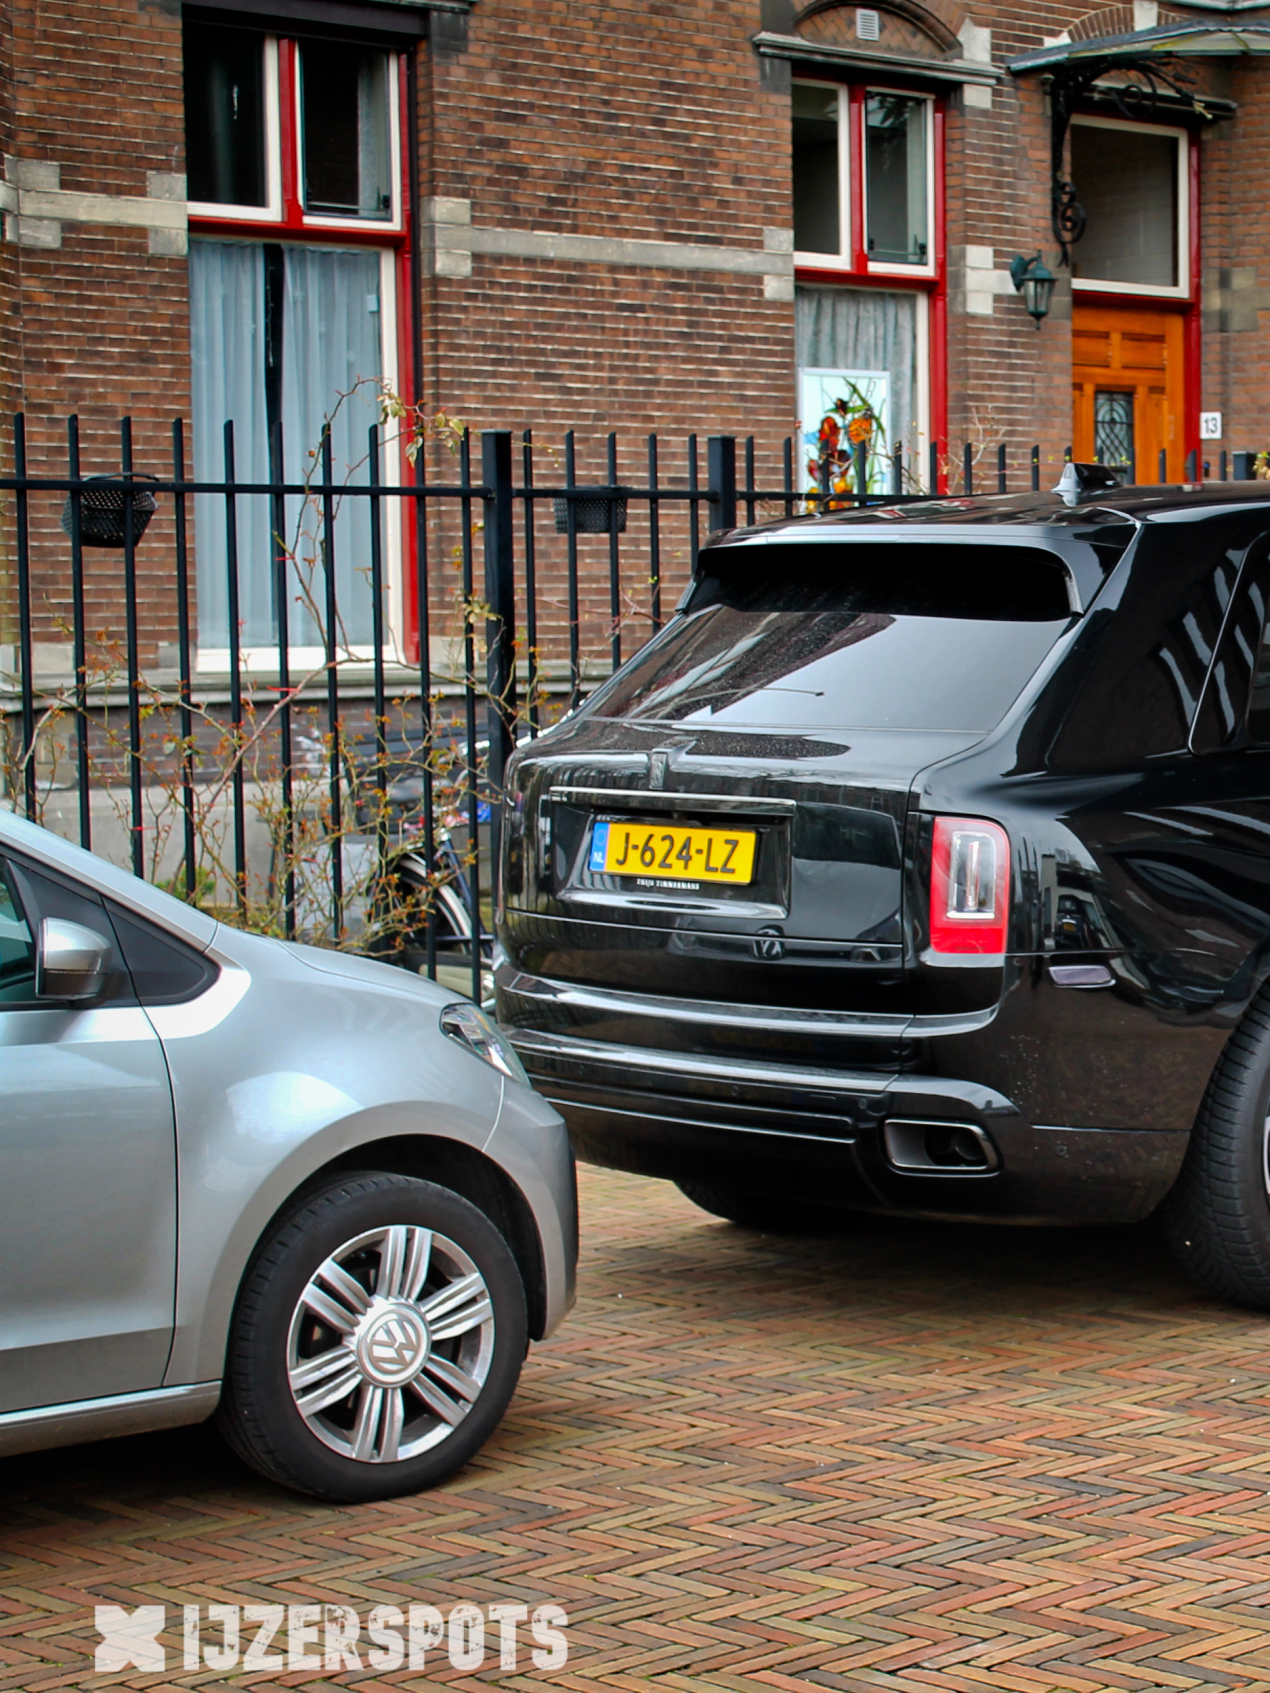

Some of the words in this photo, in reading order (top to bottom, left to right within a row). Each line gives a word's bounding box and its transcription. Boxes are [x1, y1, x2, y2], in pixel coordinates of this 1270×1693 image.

[1204, 416, 1218, 434] 13
[593, 851, 604, 864] NL
[615, 832, 739, 874] J-624-LZ
